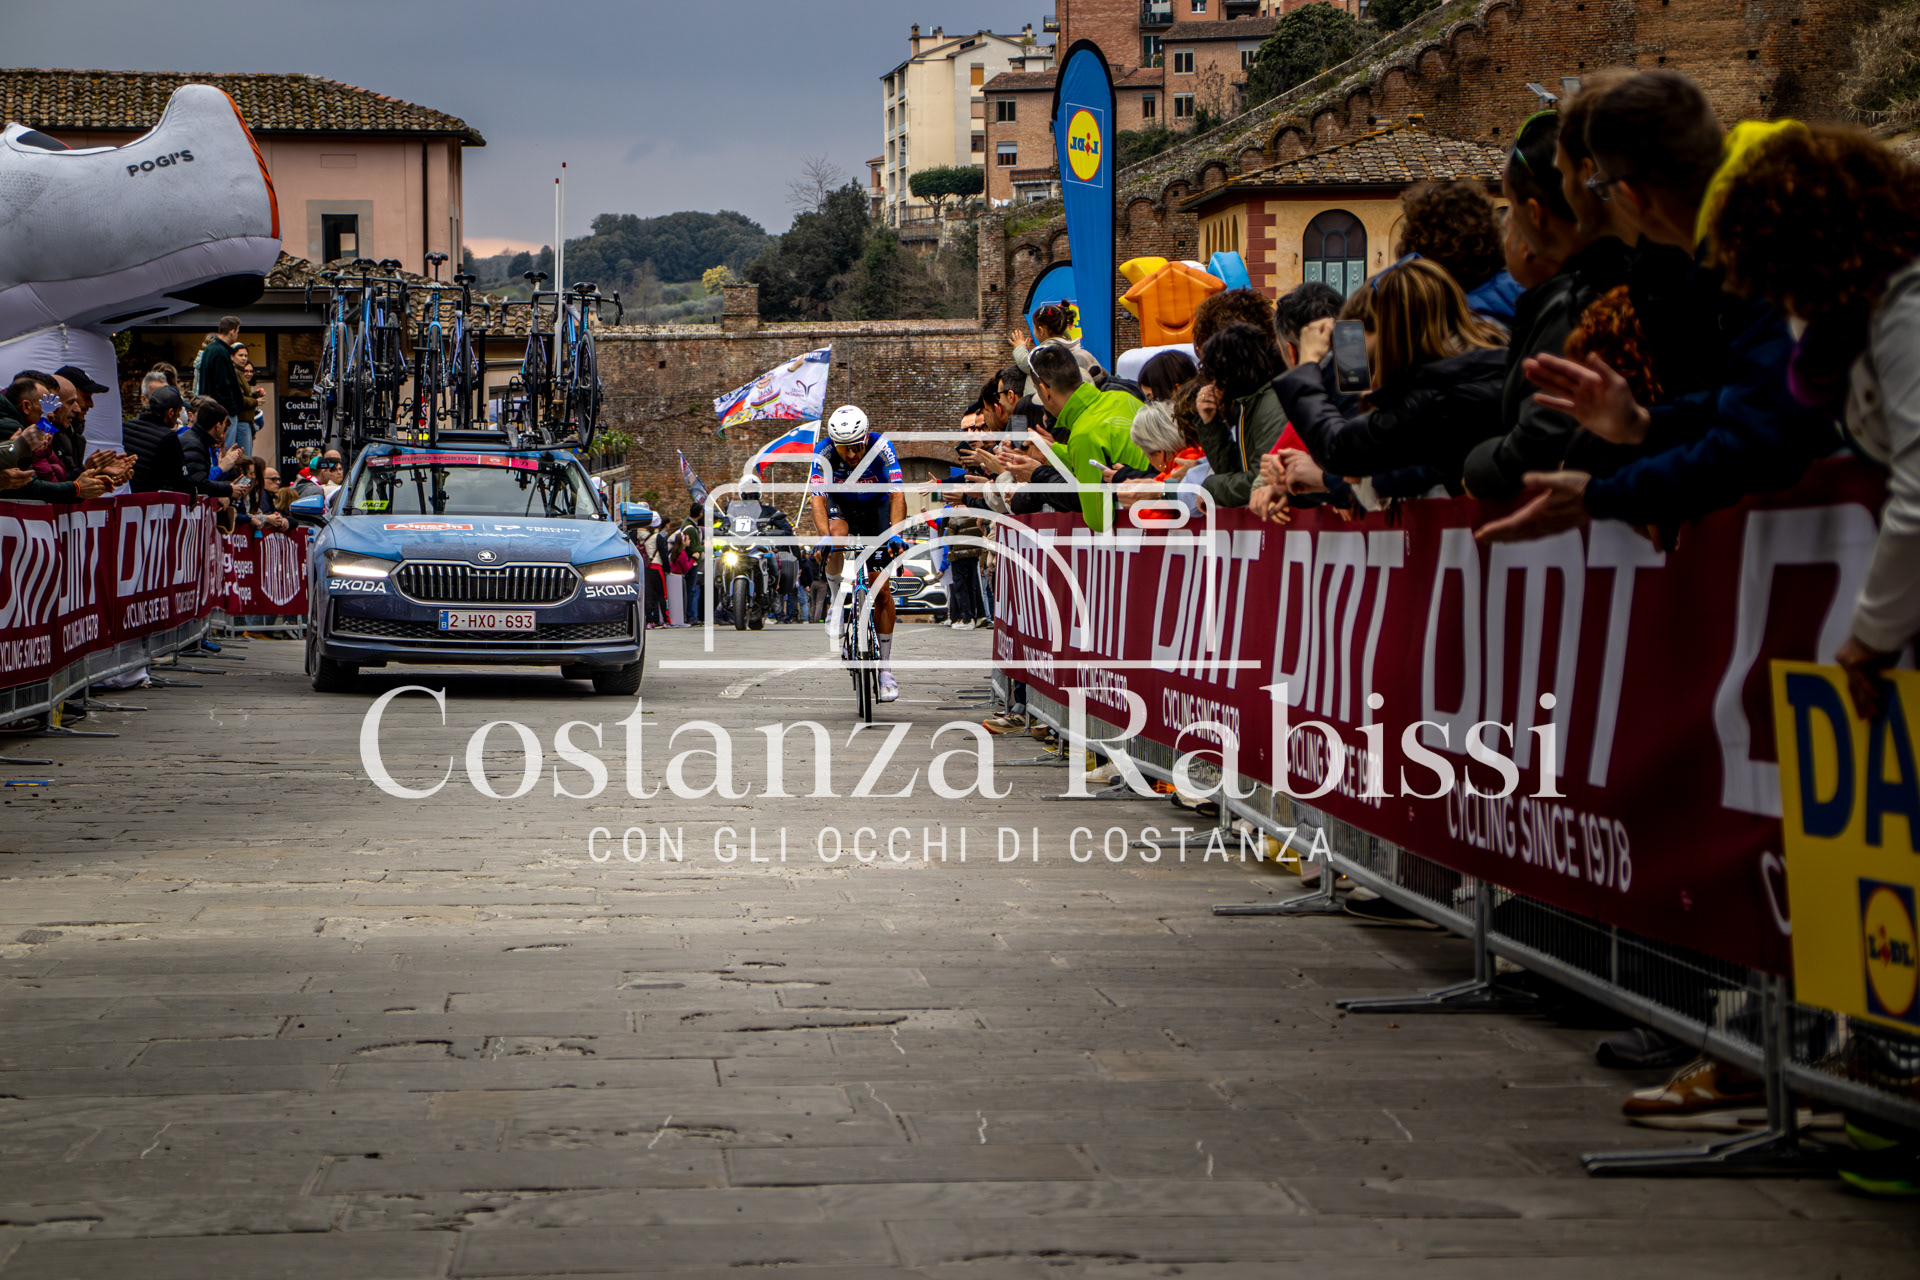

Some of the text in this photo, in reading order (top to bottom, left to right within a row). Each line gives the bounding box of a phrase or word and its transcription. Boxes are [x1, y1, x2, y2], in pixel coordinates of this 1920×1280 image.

[282, 422, 302, 430] Wine
[286, 401, 318, 410] Cocktail
[298, 412, 306, 420] &
[740, 522, 746, 531] 7
[1069, 528, 1143, 660] DMT
[1151, 529, 1260, 689] DMT
[1270, 530, 1404, 730] DMT
[1421, 519, 1666, 788] DMT
[1162, 687, 1241, 752] CYCLING SINCE 1978
[1285, 724, 1382, 809] CYCLING SINCE 1978
[1446, 779, 1633, 893] CYCLING SINCE 1978
